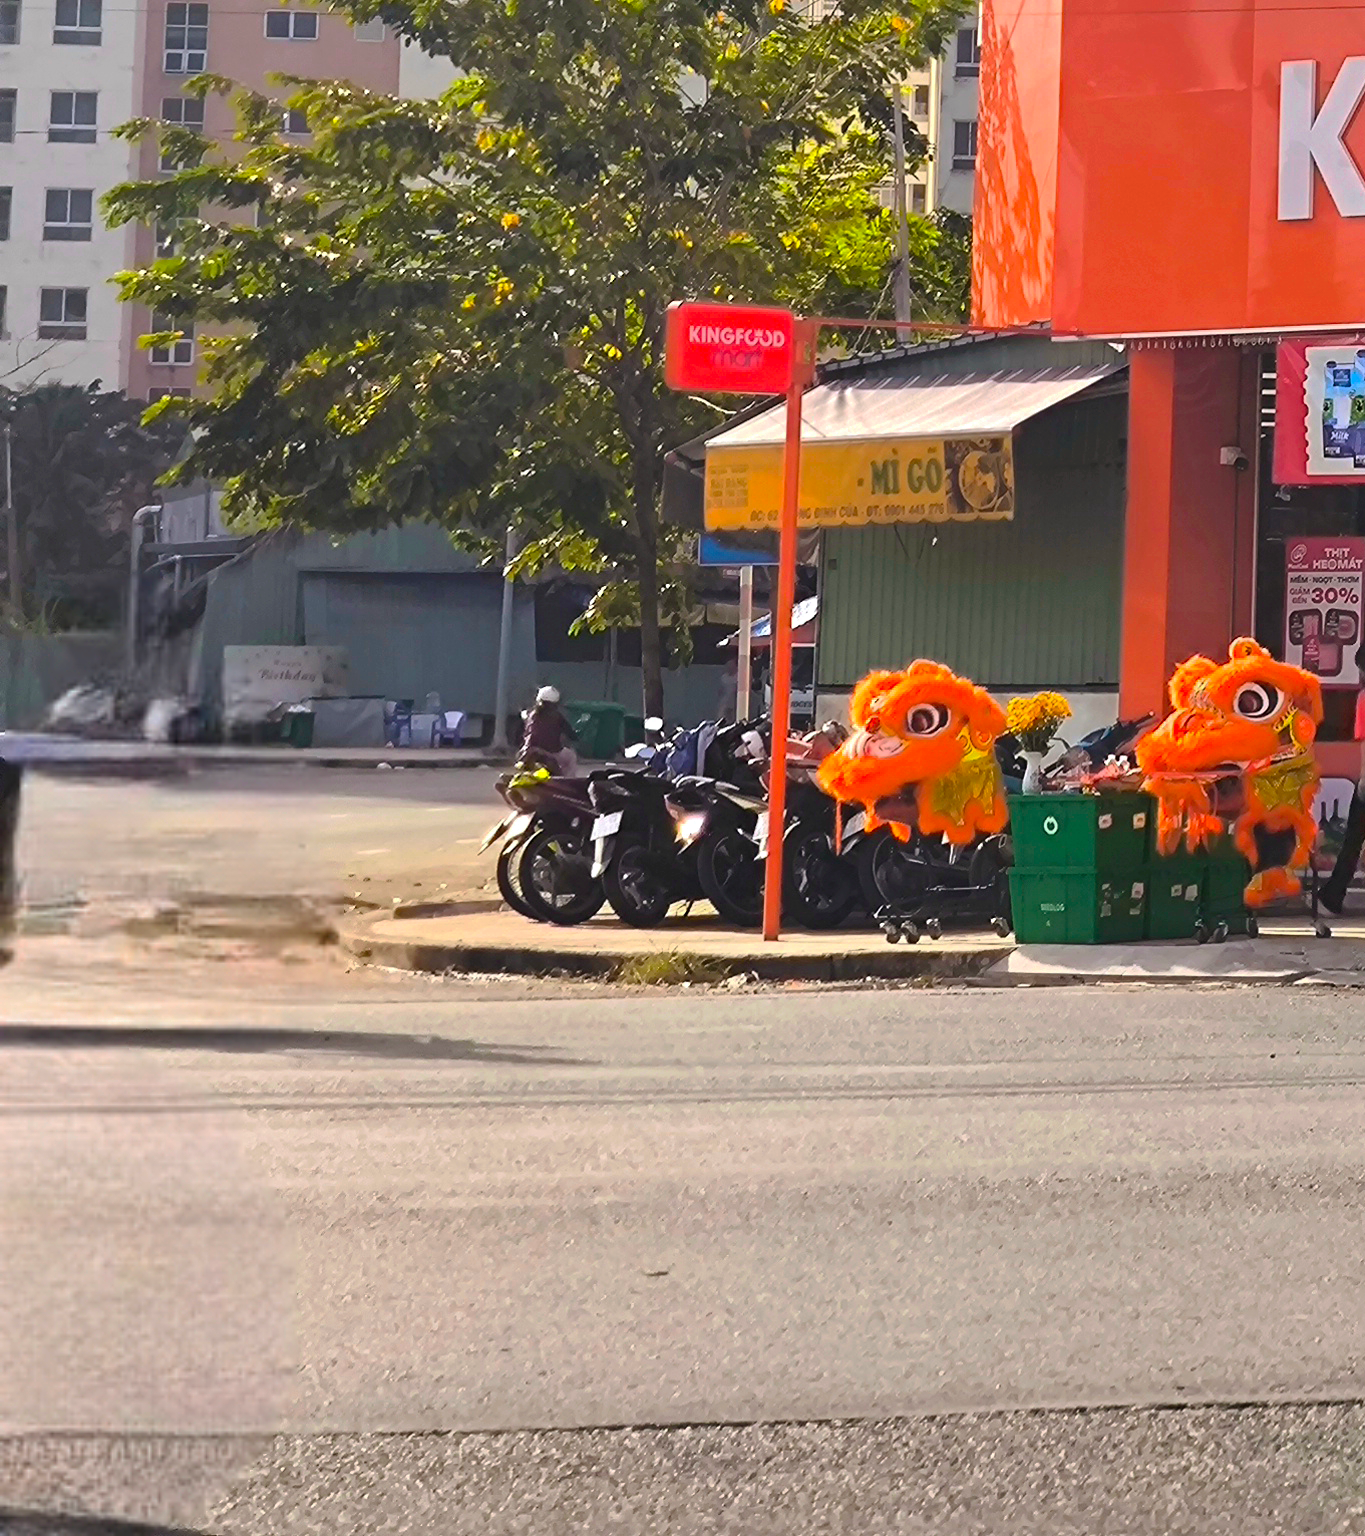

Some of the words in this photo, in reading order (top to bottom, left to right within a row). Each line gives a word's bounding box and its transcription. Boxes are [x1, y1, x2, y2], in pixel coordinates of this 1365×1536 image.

[689, 325, 785, 348] KINGFOOD
[870, 448, 900, 496] MÌ
[1324, 547, 1351, 559] THỊT
[1311, 587, 1360, 604] 30%
